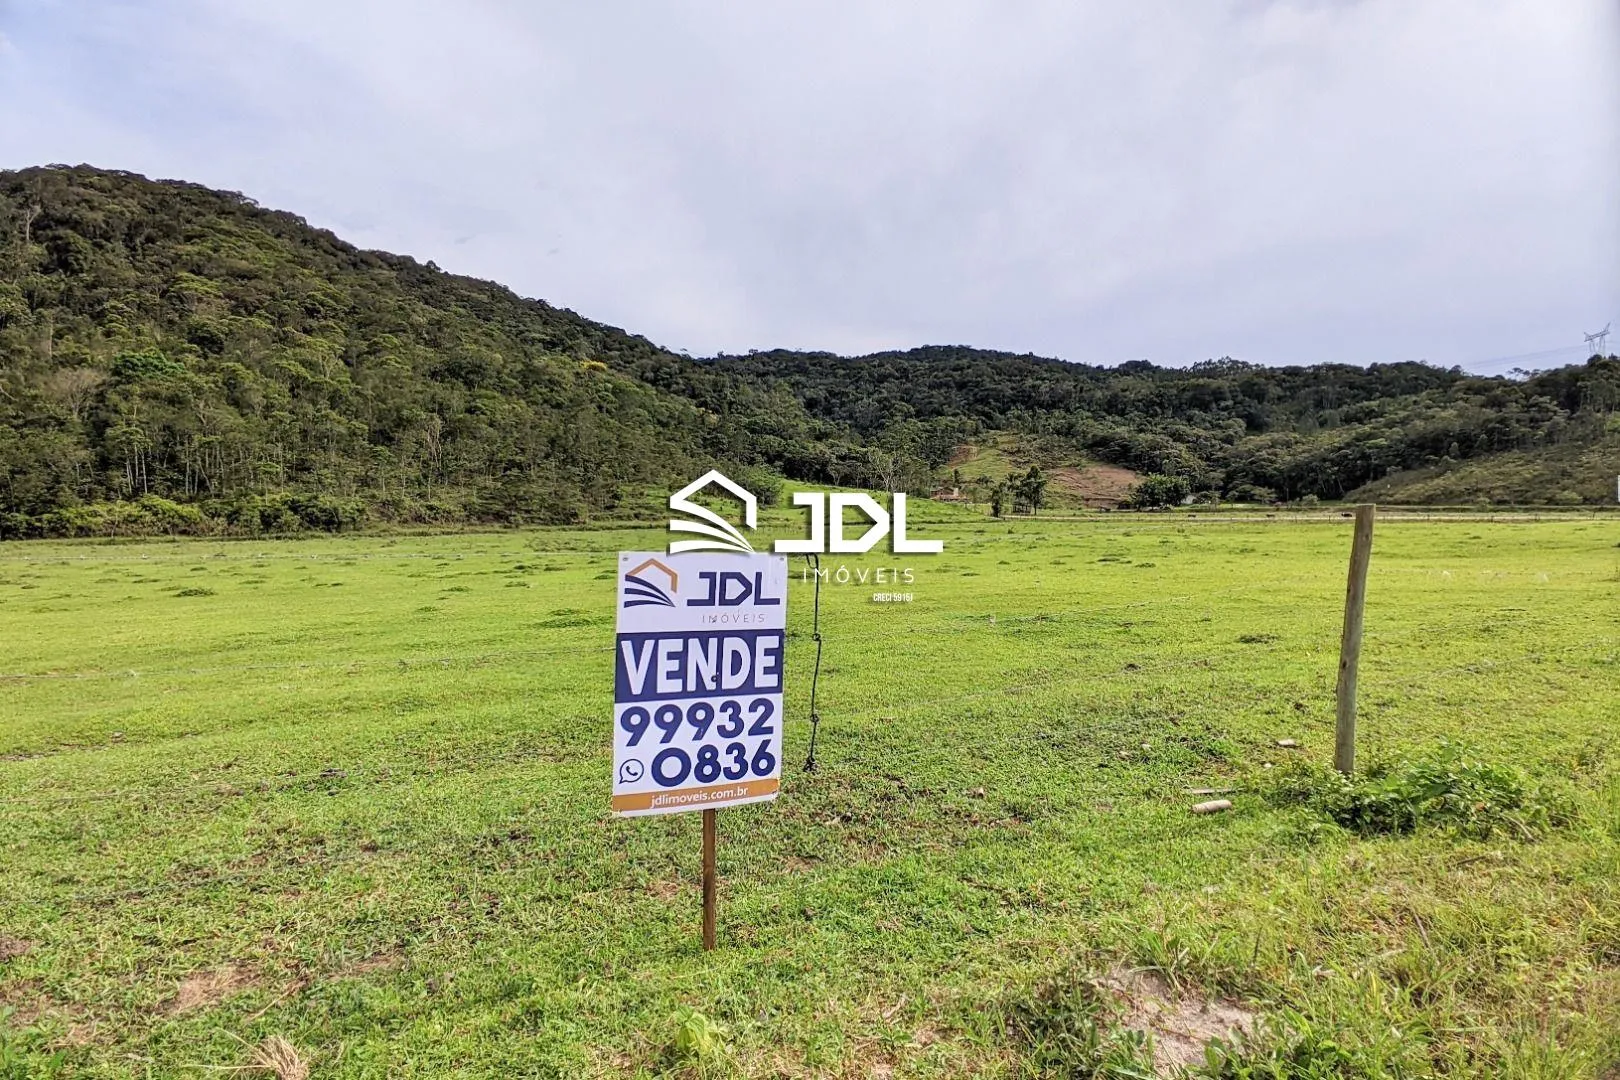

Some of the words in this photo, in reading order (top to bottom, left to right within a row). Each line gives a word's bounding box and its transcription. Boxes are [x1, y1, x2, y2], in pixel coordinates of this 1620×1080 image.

[687, 571, 780, 606] JDL
[702, 612, 765, 624] IMÓVEIS
[621, 636, 779, 695] VENDE
[620, 698, 774, 747] 99932
[651, 739, 776, 787] 0836
[651, 786, 748, 809] jdlimoveis.com.br
